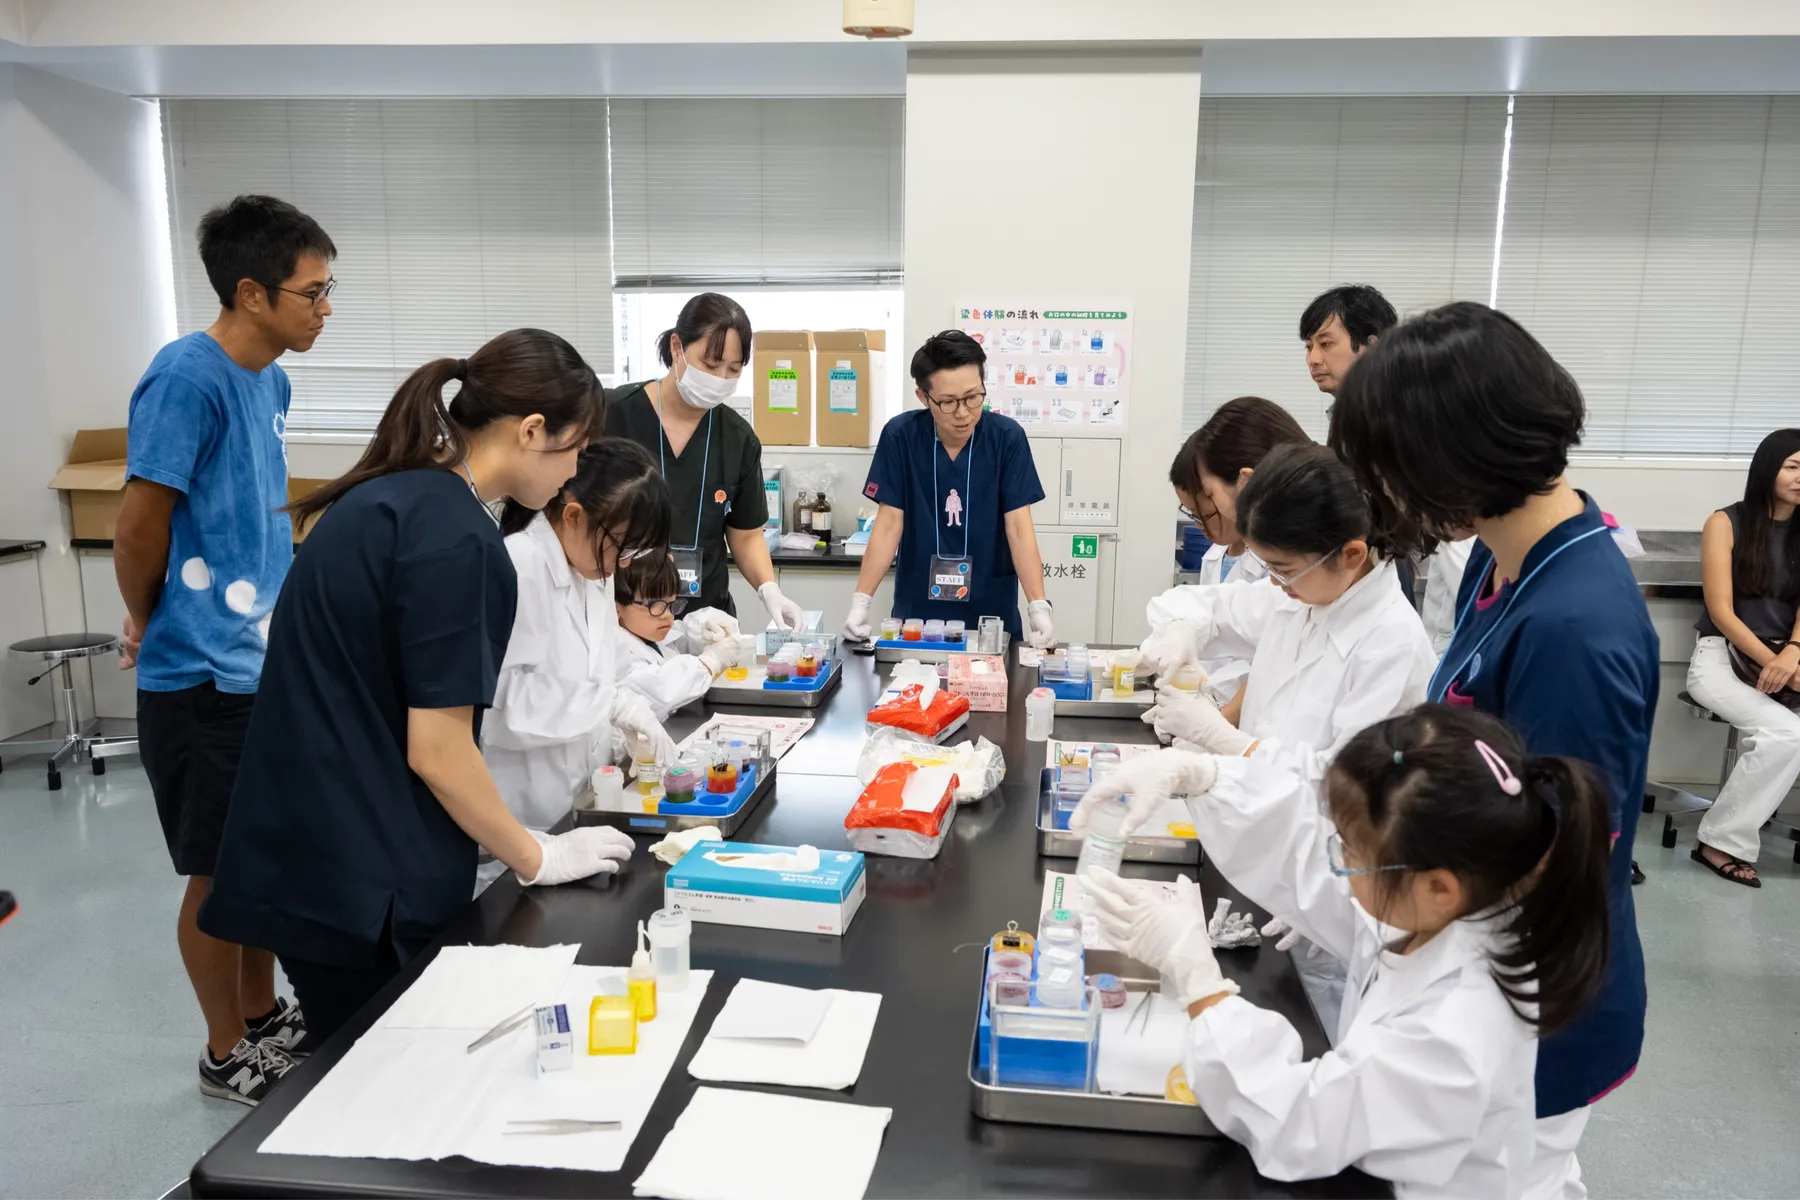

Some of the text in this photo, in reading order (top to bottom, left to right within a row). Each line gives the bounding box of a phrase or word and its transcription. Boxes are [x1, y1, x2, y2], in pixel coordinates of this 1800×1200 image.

[961, 308, 1039, 320] 染色体験の流れ
[1001, 328, 1007, 336] 2
[1042, 328, 1047, 336] 3
[1006, 363, 1013, 371] 7
[1087, 364, 1092, 372] 5
[1012, 397, 1023, 406] 10
[1051, 398, 1061, 406] 11
[1092, 399, 1102, 407] 12
[937, 576, 963, 584] STAFF
[226, 1065, 264, 1096] N
